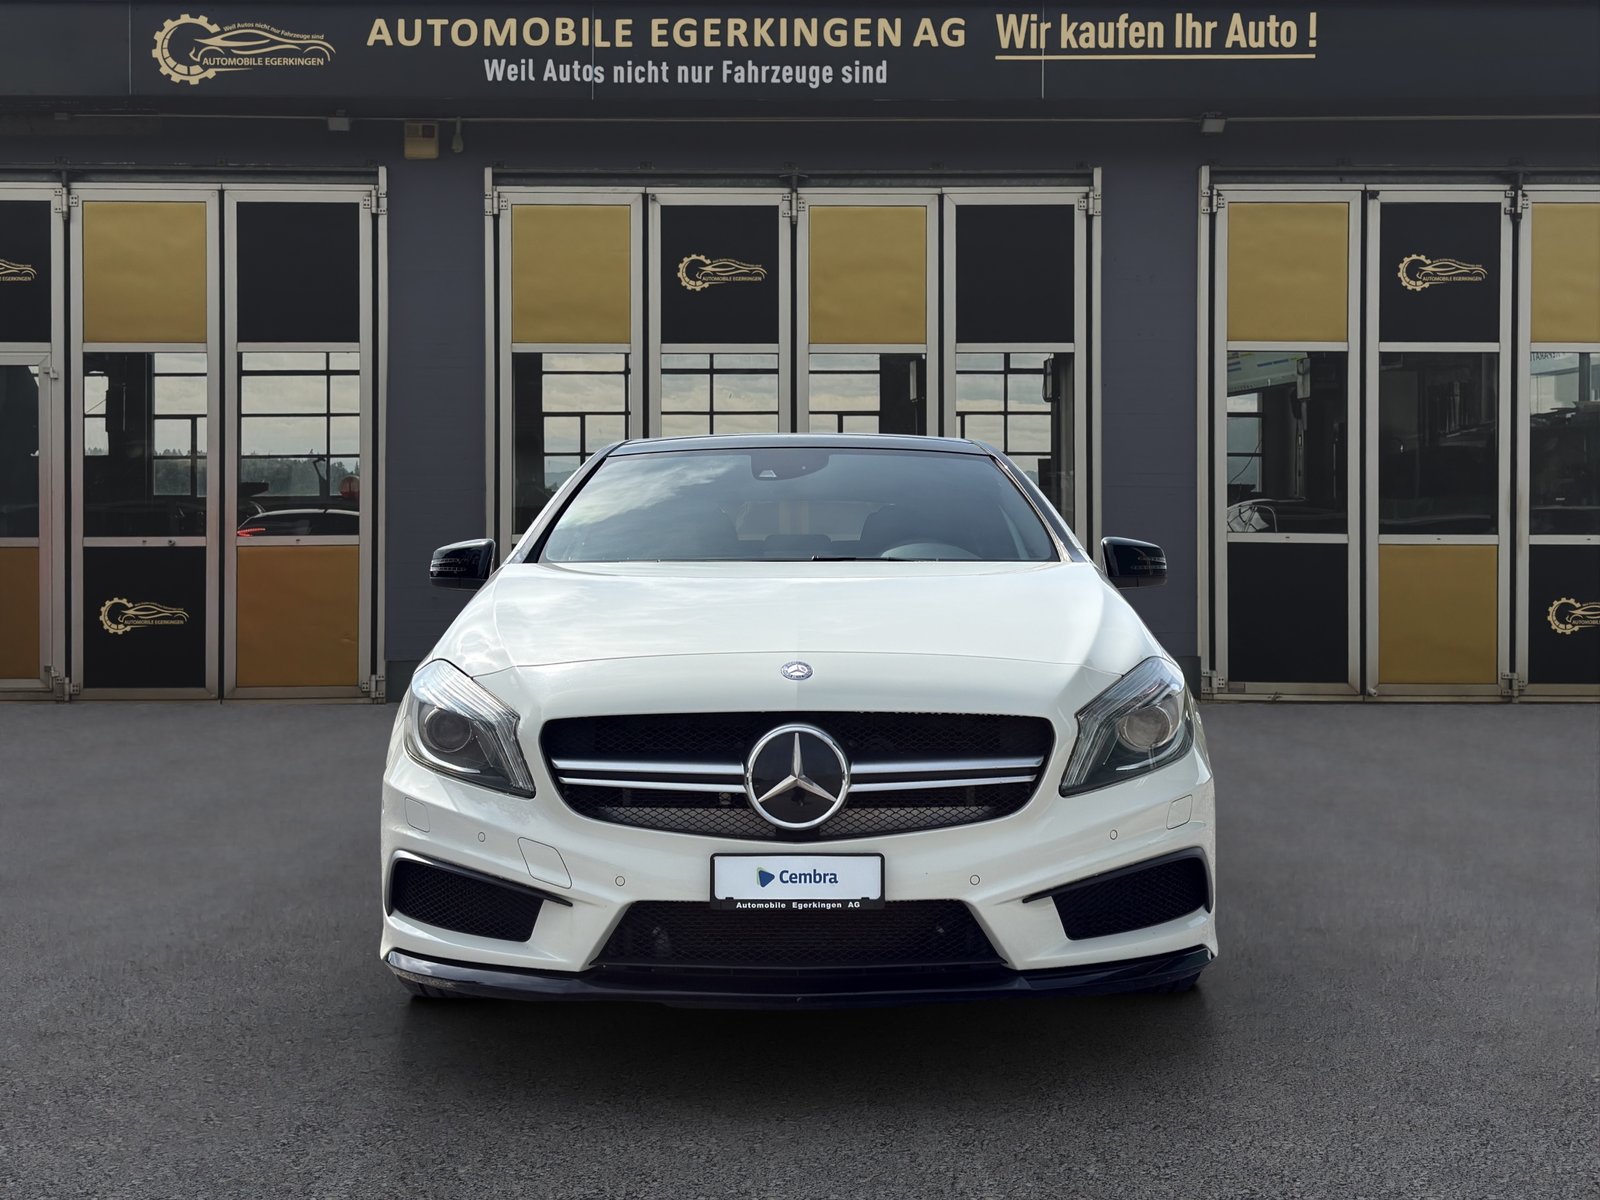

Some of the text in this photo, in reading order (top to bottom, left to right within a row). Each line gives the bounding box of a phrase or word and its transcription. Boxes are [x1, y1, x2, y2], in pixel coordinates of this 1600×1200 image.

[367, 17, 966, 47] AUTOMOBILE EGERKINGEN AG
[995, 13, 1051, 49] Wir
[1060, 12, 1164, 49] kaufen
[1174, 12, 1218, 48] Ihr
[1225, 12, 1298, 48] Auto
[202, 57, 324, 66] AUTOMOBILE EGERKINGEN
[484, 58, 887, 89] Weil Autos nicht nur Fahrzeuge sind
[779, 869, 839, 884] Cembra
[736, 901, 787, 909] Automobile
[792, 901, 842, 910] Egerkingen
